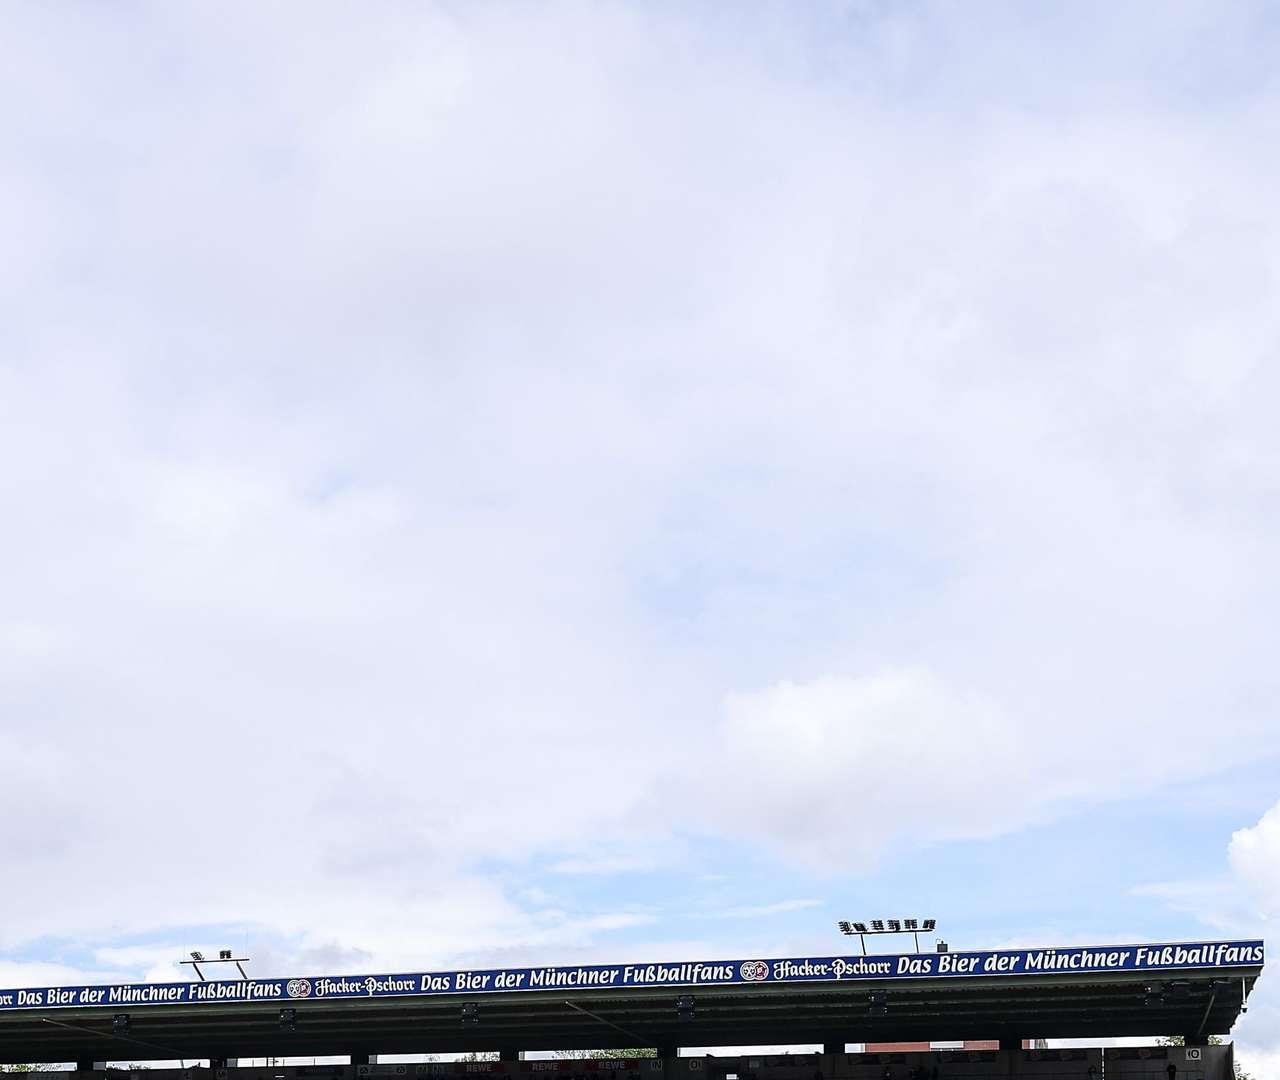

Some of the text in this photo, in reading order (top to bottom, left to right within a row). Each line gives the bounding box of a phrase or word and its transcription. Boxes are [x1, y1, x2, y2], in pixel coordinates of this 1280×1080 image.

[773, 942, 1264, 980] Hacker-Pschorr Das Bier der Münchner Fußballfans
[17, 991, 43, 1005] Das
[46, 989, 76, 1004] Bier
[80, 988, 105, 1003] der
[108, 984, 185, 1002] Münchner
[188, 980, 282, 1000] Fußballfans
[315, 963, 733, 997] Hacker-Pschorr Das Bier der Münchner Fußballfans
